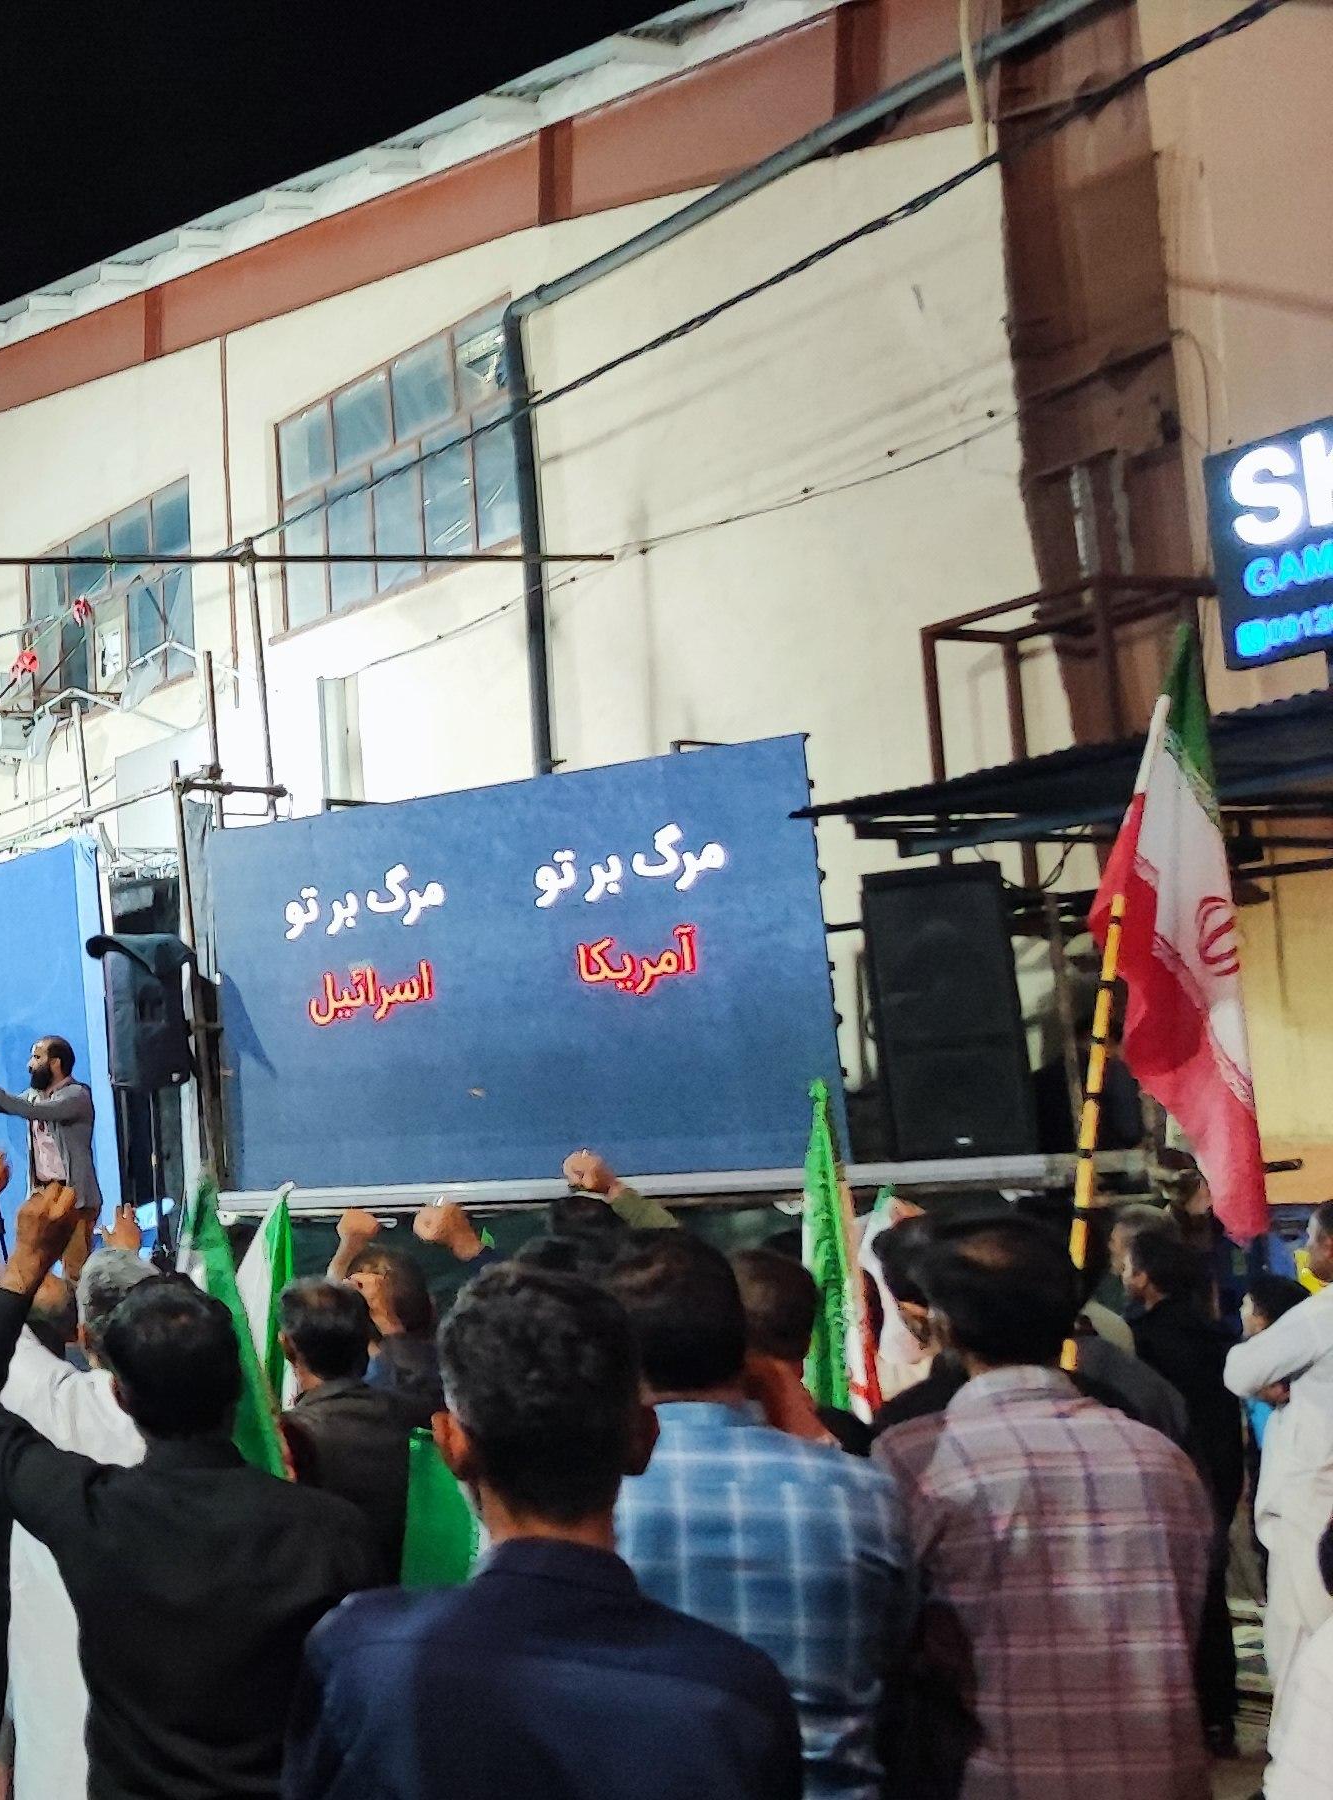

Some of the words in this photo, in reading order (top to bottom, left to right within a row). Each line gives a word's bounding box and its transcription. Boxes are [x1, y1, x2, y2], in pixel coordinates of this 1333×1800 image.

[533, 847, 577, 909] تو
[583, 852, 623, 904] بر
[631, 822, 727, 893] مرگ
[284, 885, 319, 941] تو
[326, 890, 358, 936] بر
[365, 863, 447, 927] مرگ
[576, 923, 697, 997] آمریکا
[308, 959, 435, 1027] اسرائیل
